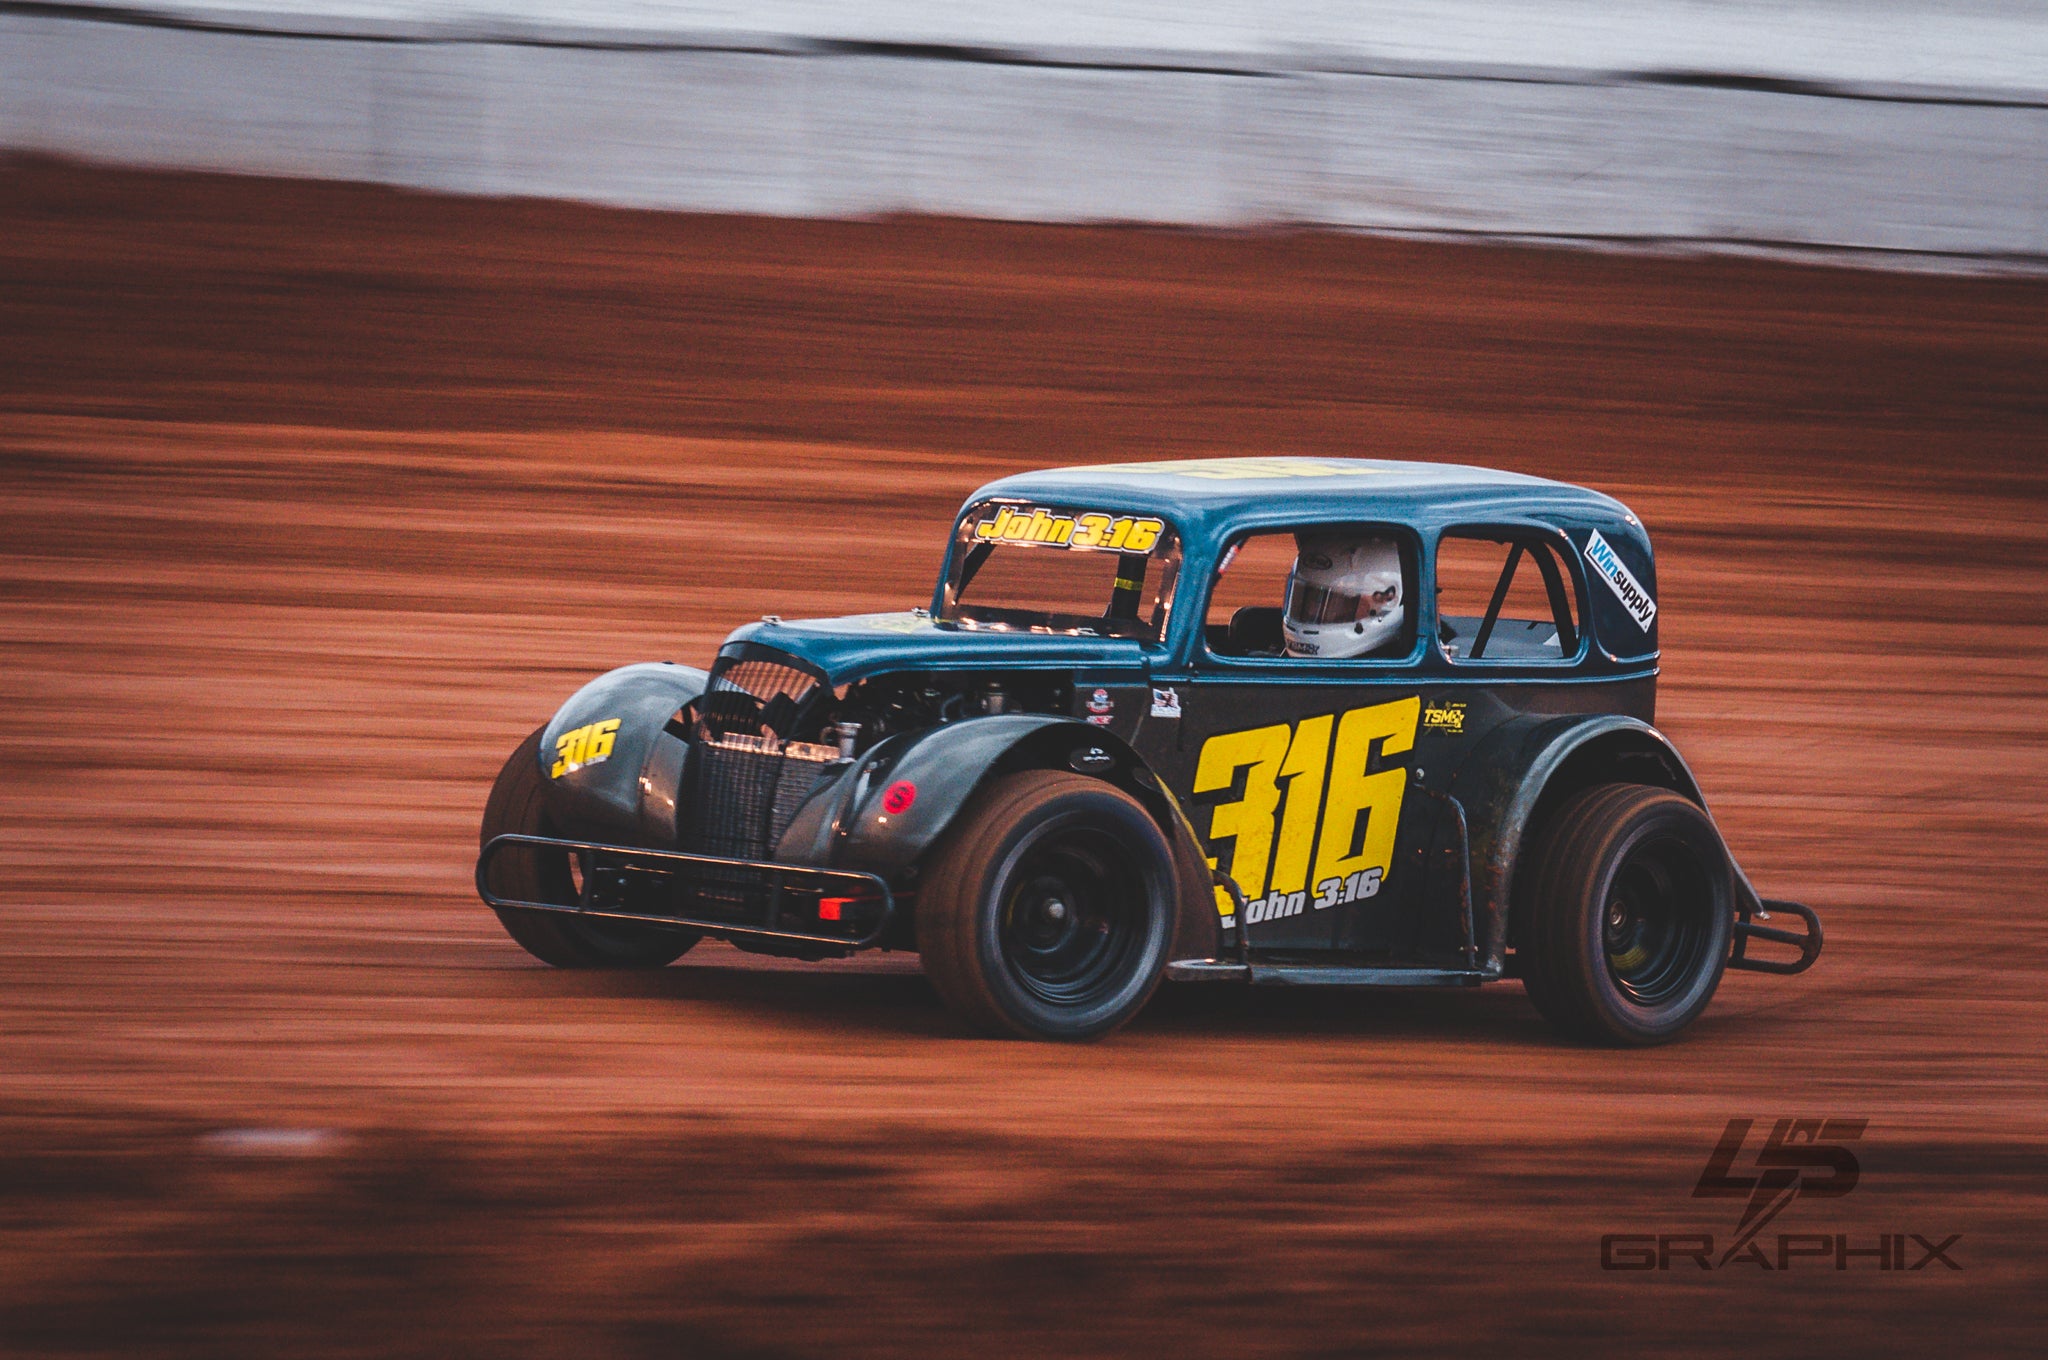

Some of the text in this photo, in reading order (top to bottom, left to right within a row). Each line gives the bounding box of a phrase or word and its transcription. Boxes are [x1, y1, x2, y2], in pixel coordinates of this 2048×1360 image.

[975, 505, 1163, 552] John 3:16
[1591, 537, 1653, 623] Winsupply
[551, 717, 622, 779] 316
[1193, 695, 1421, 917] 316
[1313, 867, 1383, 910] 3:16
